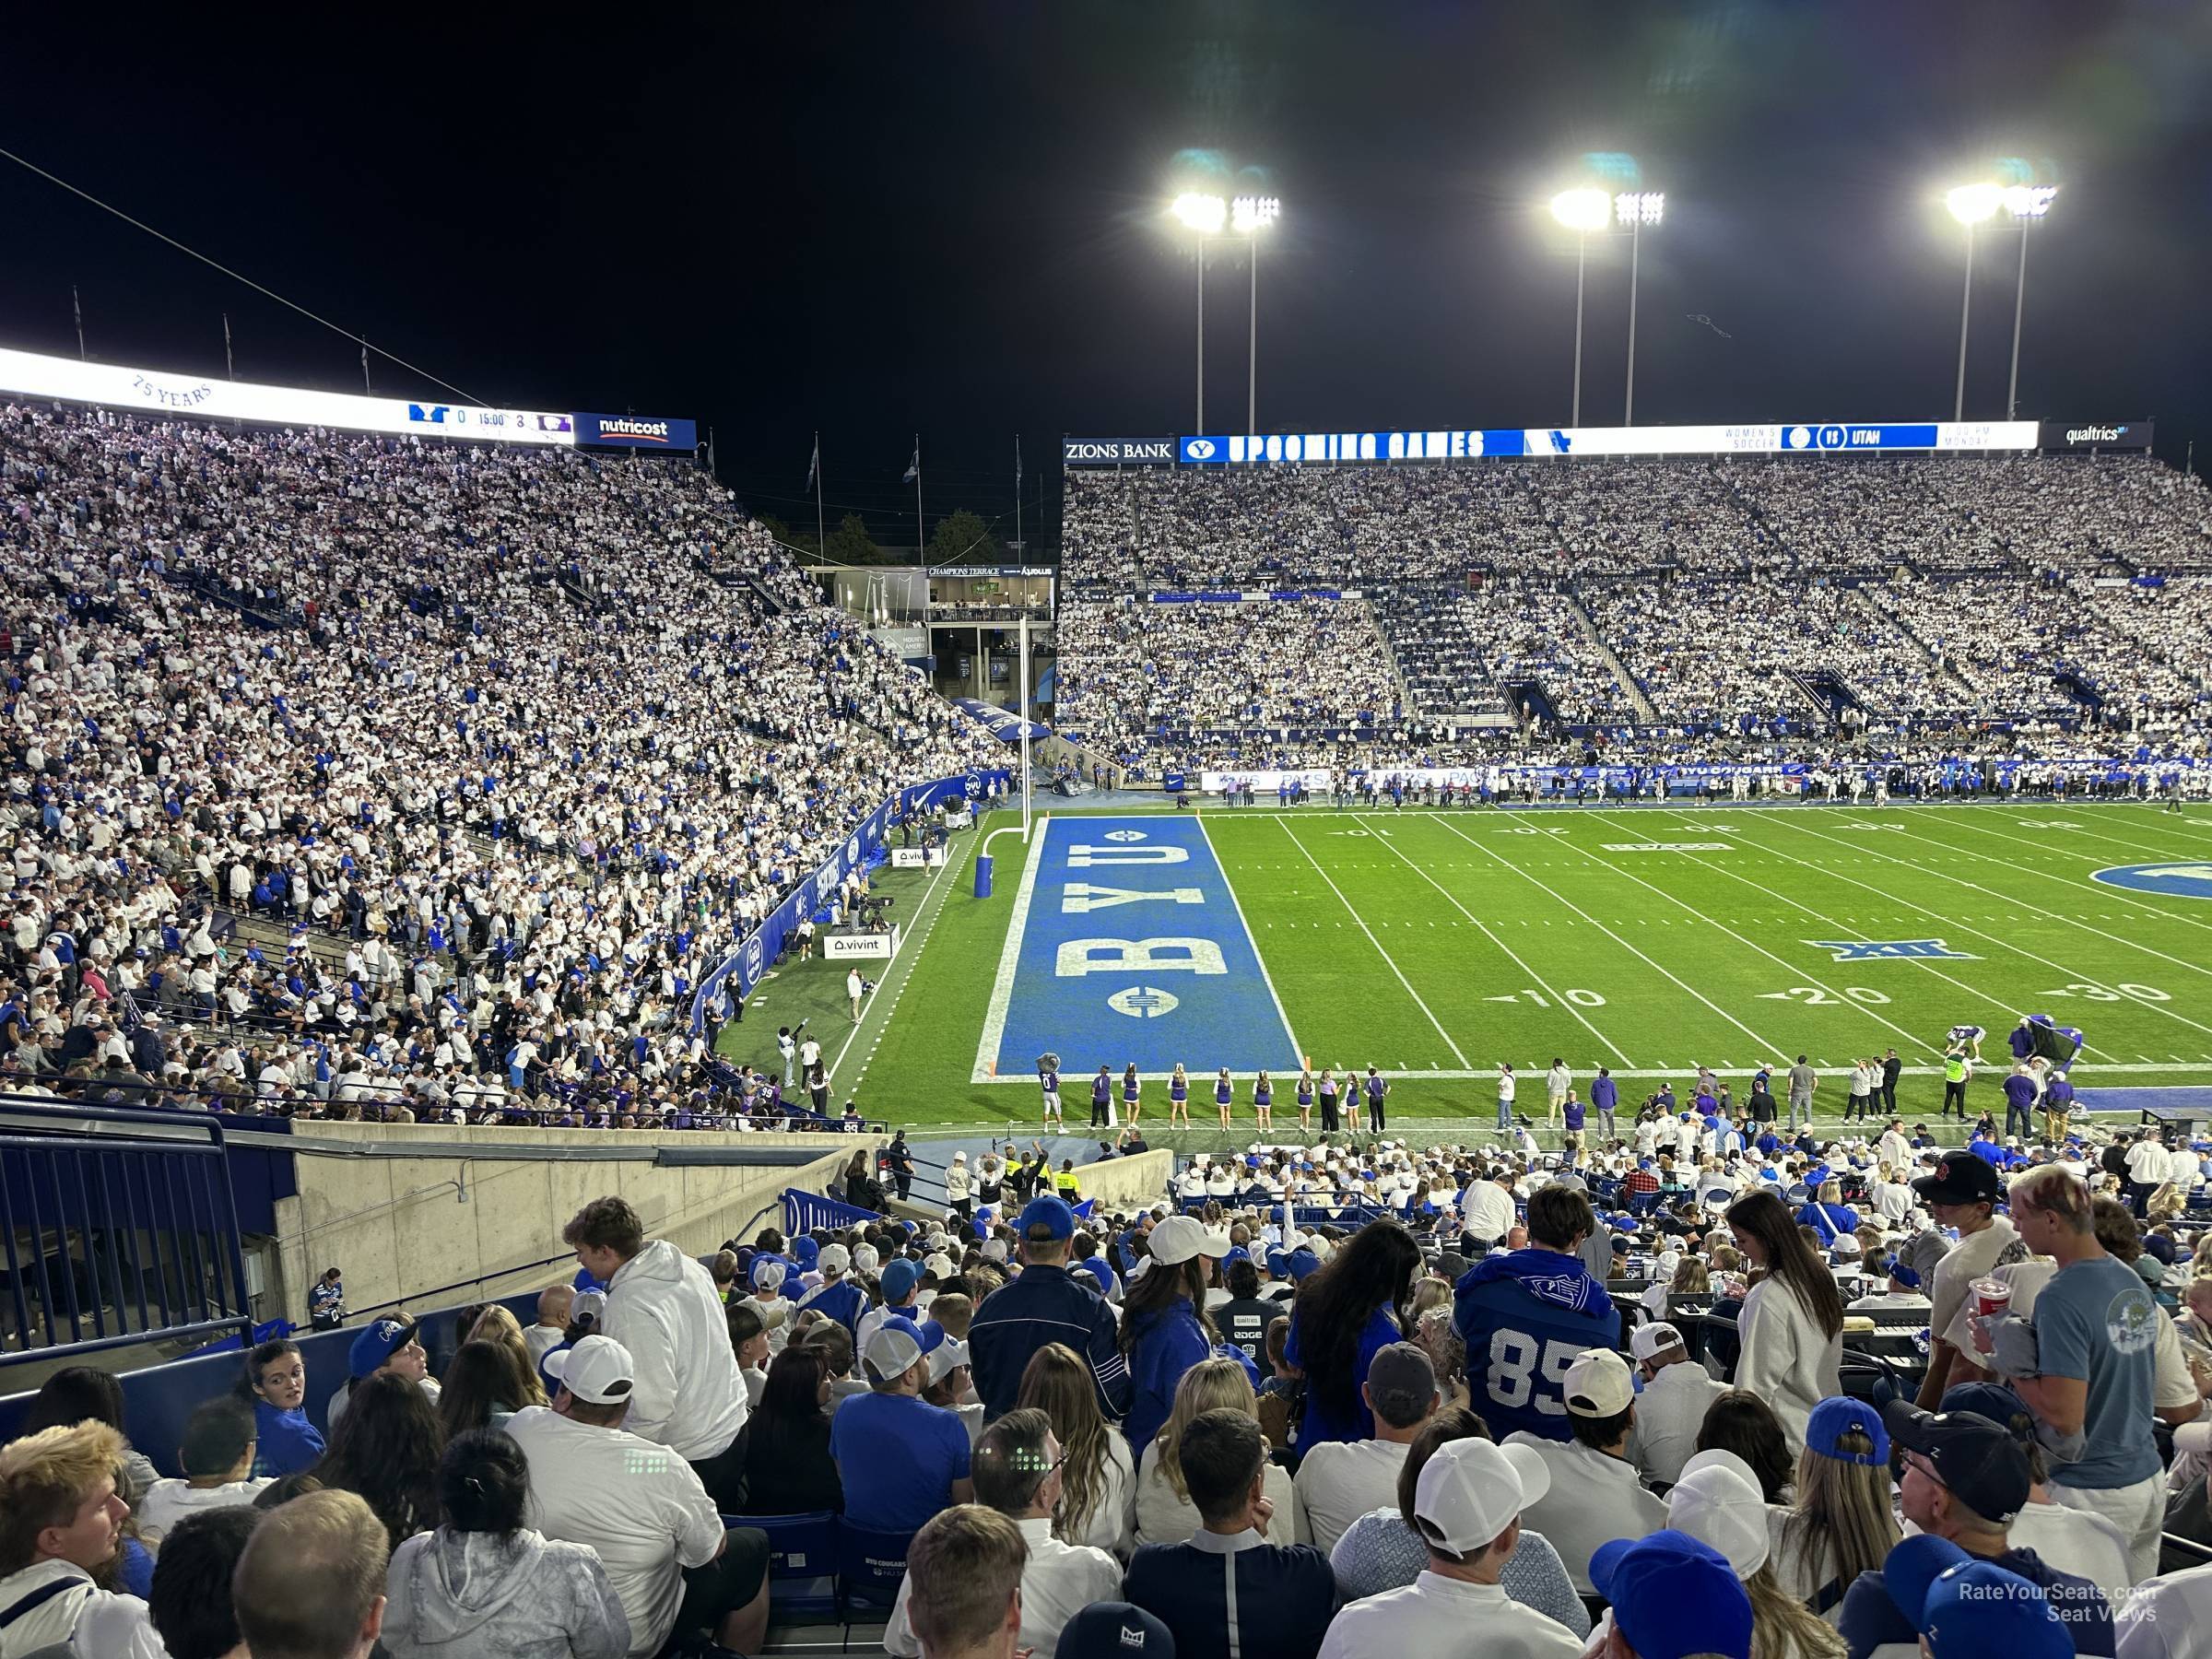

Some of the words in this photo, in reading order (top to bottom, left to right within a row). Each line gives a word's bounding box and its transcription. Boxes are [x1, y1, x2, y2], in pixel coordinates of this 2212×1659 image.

[134, 374, 153, 396] 75
[159, 383, 211, 406] YEARS
[458, 410, 465, 424] 0
[479, 414, 504, 426] 15:00
[517, 416, 524, 428] 3
[599, 418, 667, 436] nutricost
[1734, 440, 1774, 449] SOCCER
[1826, 430, 1839, 443] VS
[1853, 429, 1880, 444] UTAH
[2066, 426, 2117, 445] qualtrics
[1066, 444, 1121, 459] ZIONS
[1124, 443, 1171, 458] BANK
[1229, 434, 1377, 462] UPCOMING
[1388, 431, 1484, 458] GAMES
[1710, 767, 1782, 775] COUGARS
[1055, 844, 1228, 977] BYU
[762, 1087, 772, 1099] 99
[1486, 1327, 1592, 1416] 85
[878, 1559, 907, 1568] COUGARS
